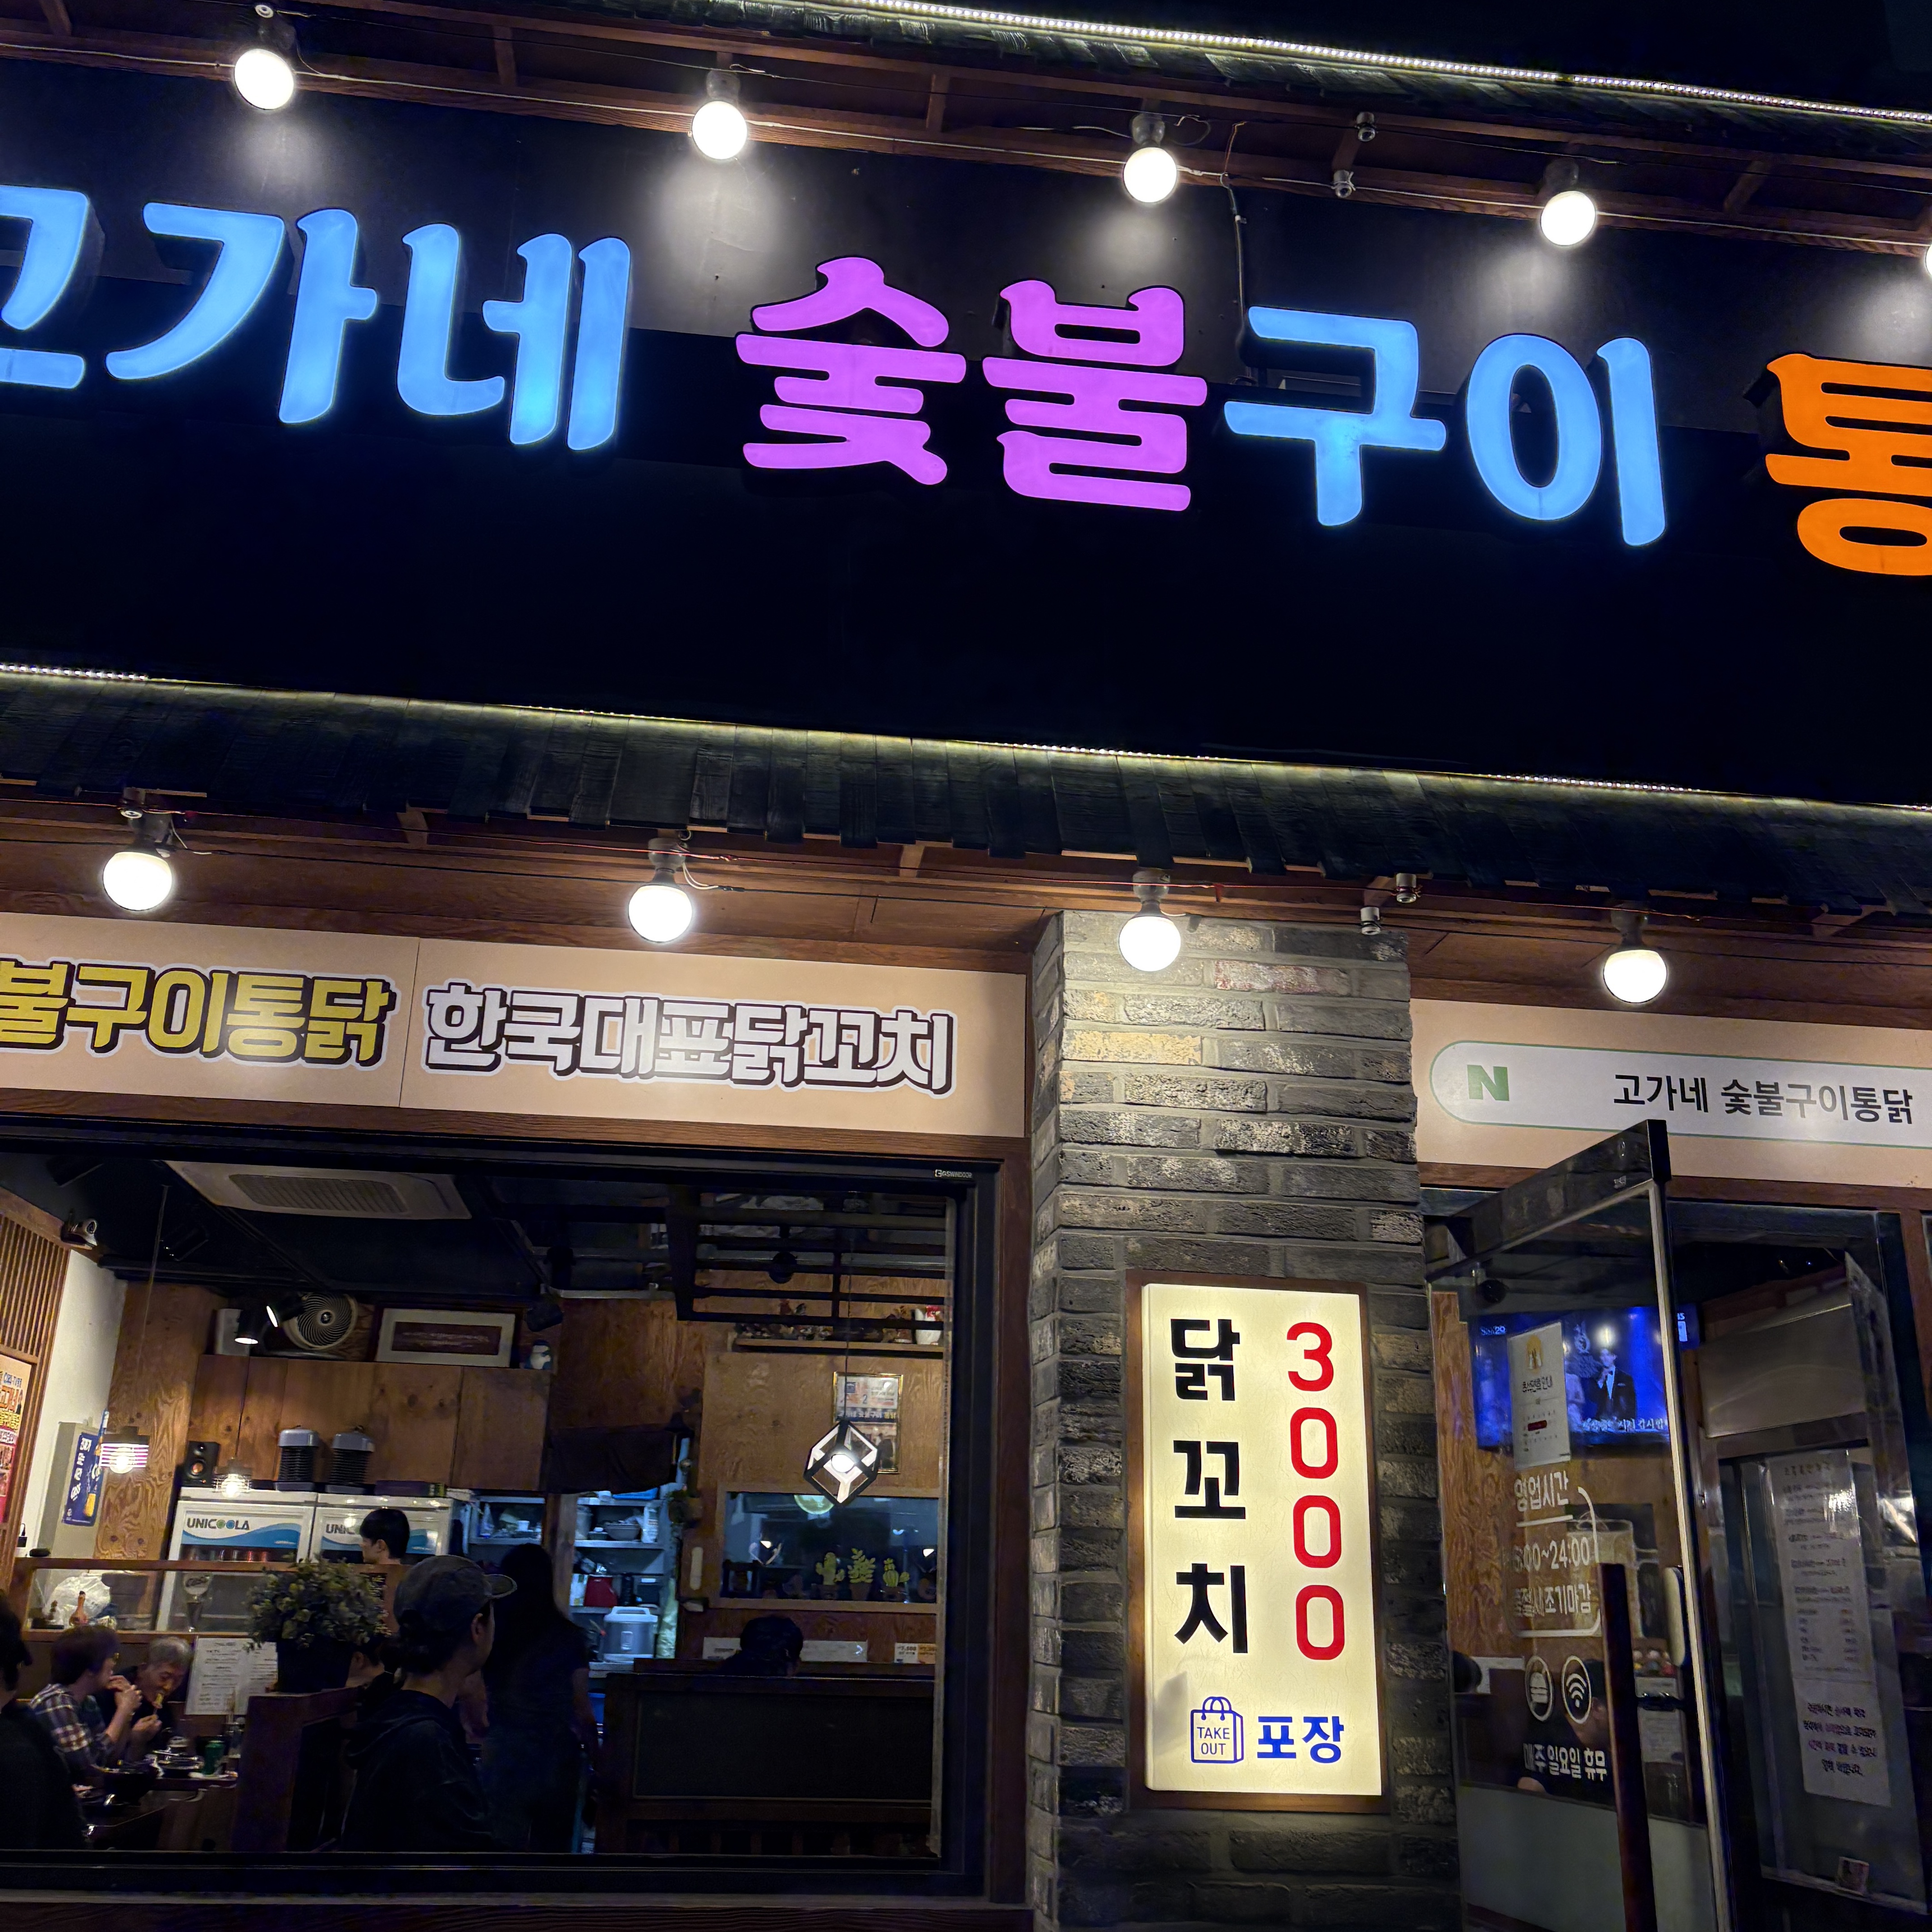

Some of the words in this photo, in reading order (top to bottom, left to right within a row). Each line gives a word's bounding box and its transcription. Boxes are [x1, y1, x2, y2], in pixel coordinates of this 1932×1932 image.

[735, 257, 1666, 547] 숯불구이
[1467, 1064, 1509, 1101] N
[1614, 1074, 1709, 1113] 고가네
[1720, 1079, 1913, 1124] 숯불구이통닭
[1286, 1321, 1345, 1660] 3000
[1514, 1470, 1569, 1512] 영업시간
[187, 1518, 249, 1530] UNICOOLA
[1197, 1726, 1230, 1740] TAKE
[1201, 1743, 1226, 1756] OUT
[1257, 1716, 1344, 1764] 포장
